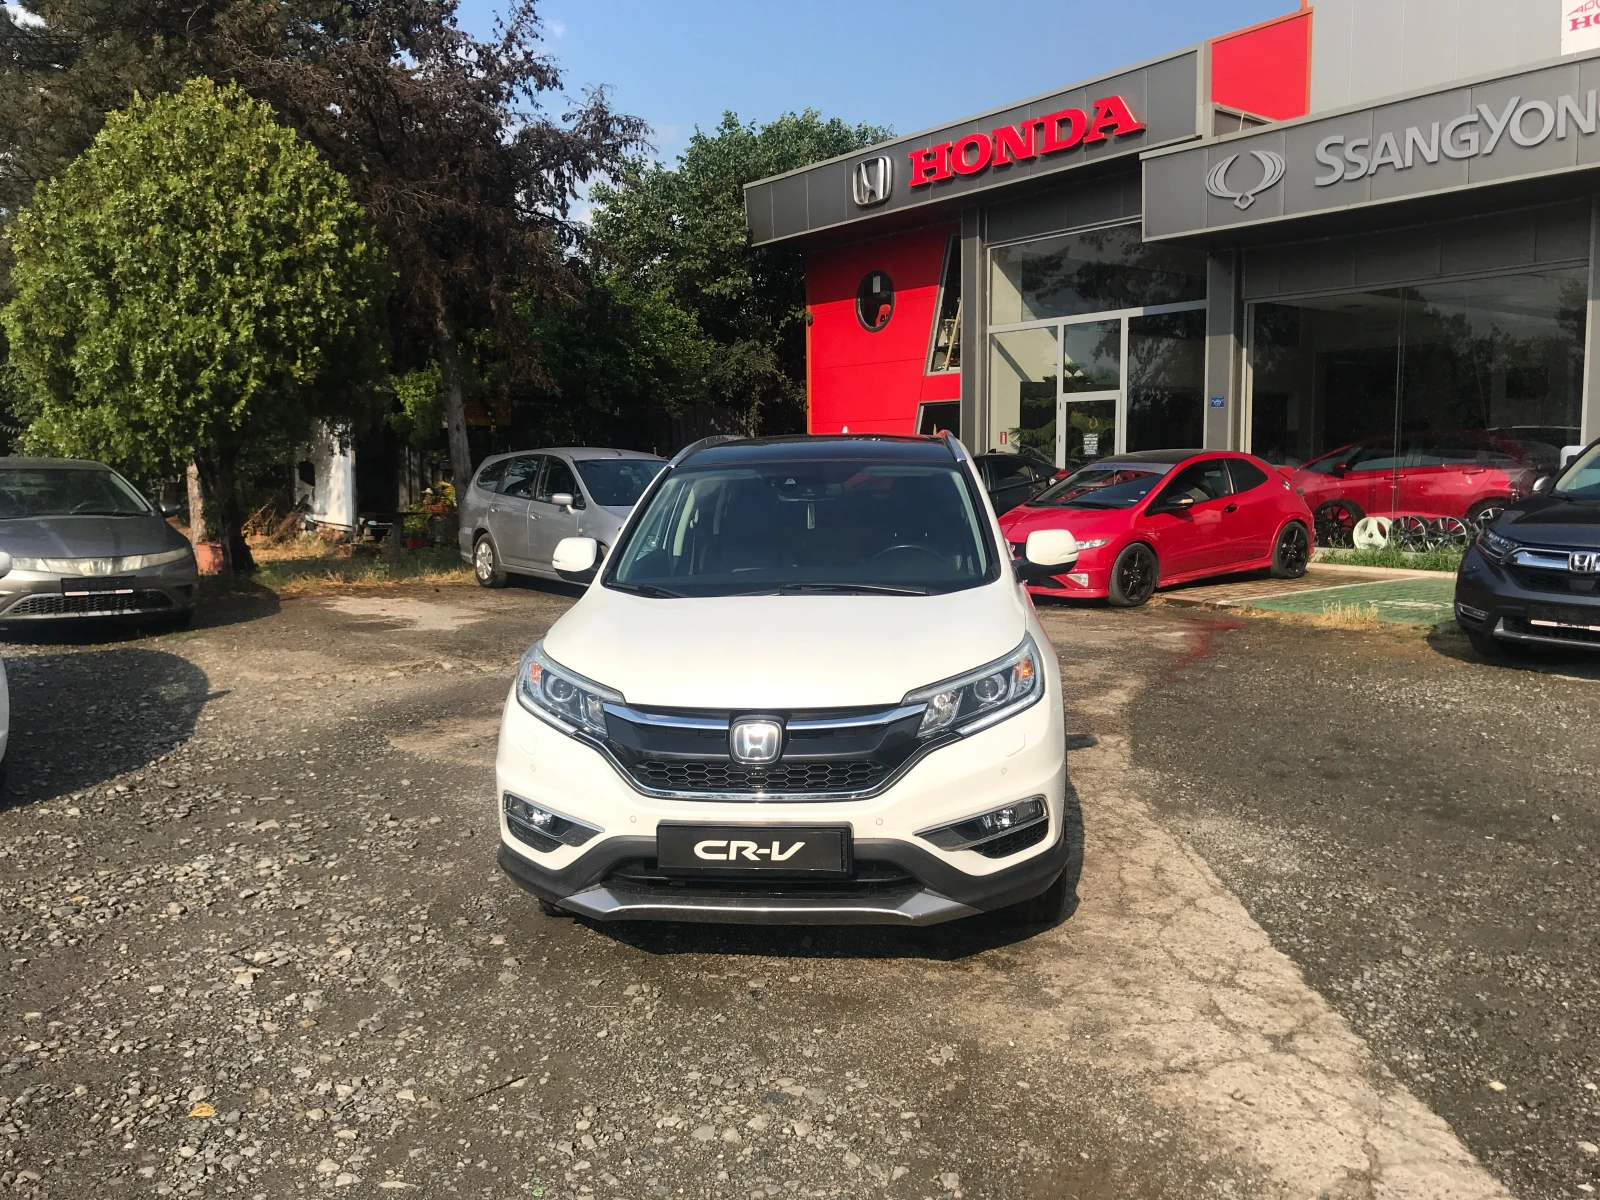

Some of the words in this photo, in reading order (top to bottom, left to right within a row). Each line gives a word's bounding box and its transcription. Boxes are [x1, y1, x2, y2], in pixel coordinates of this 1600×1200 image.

[908, 95, 1146, 187] HONDA
[1315, 90, 1600, 186] SSANGYON
[694, 840, 806, 861] CR-V
